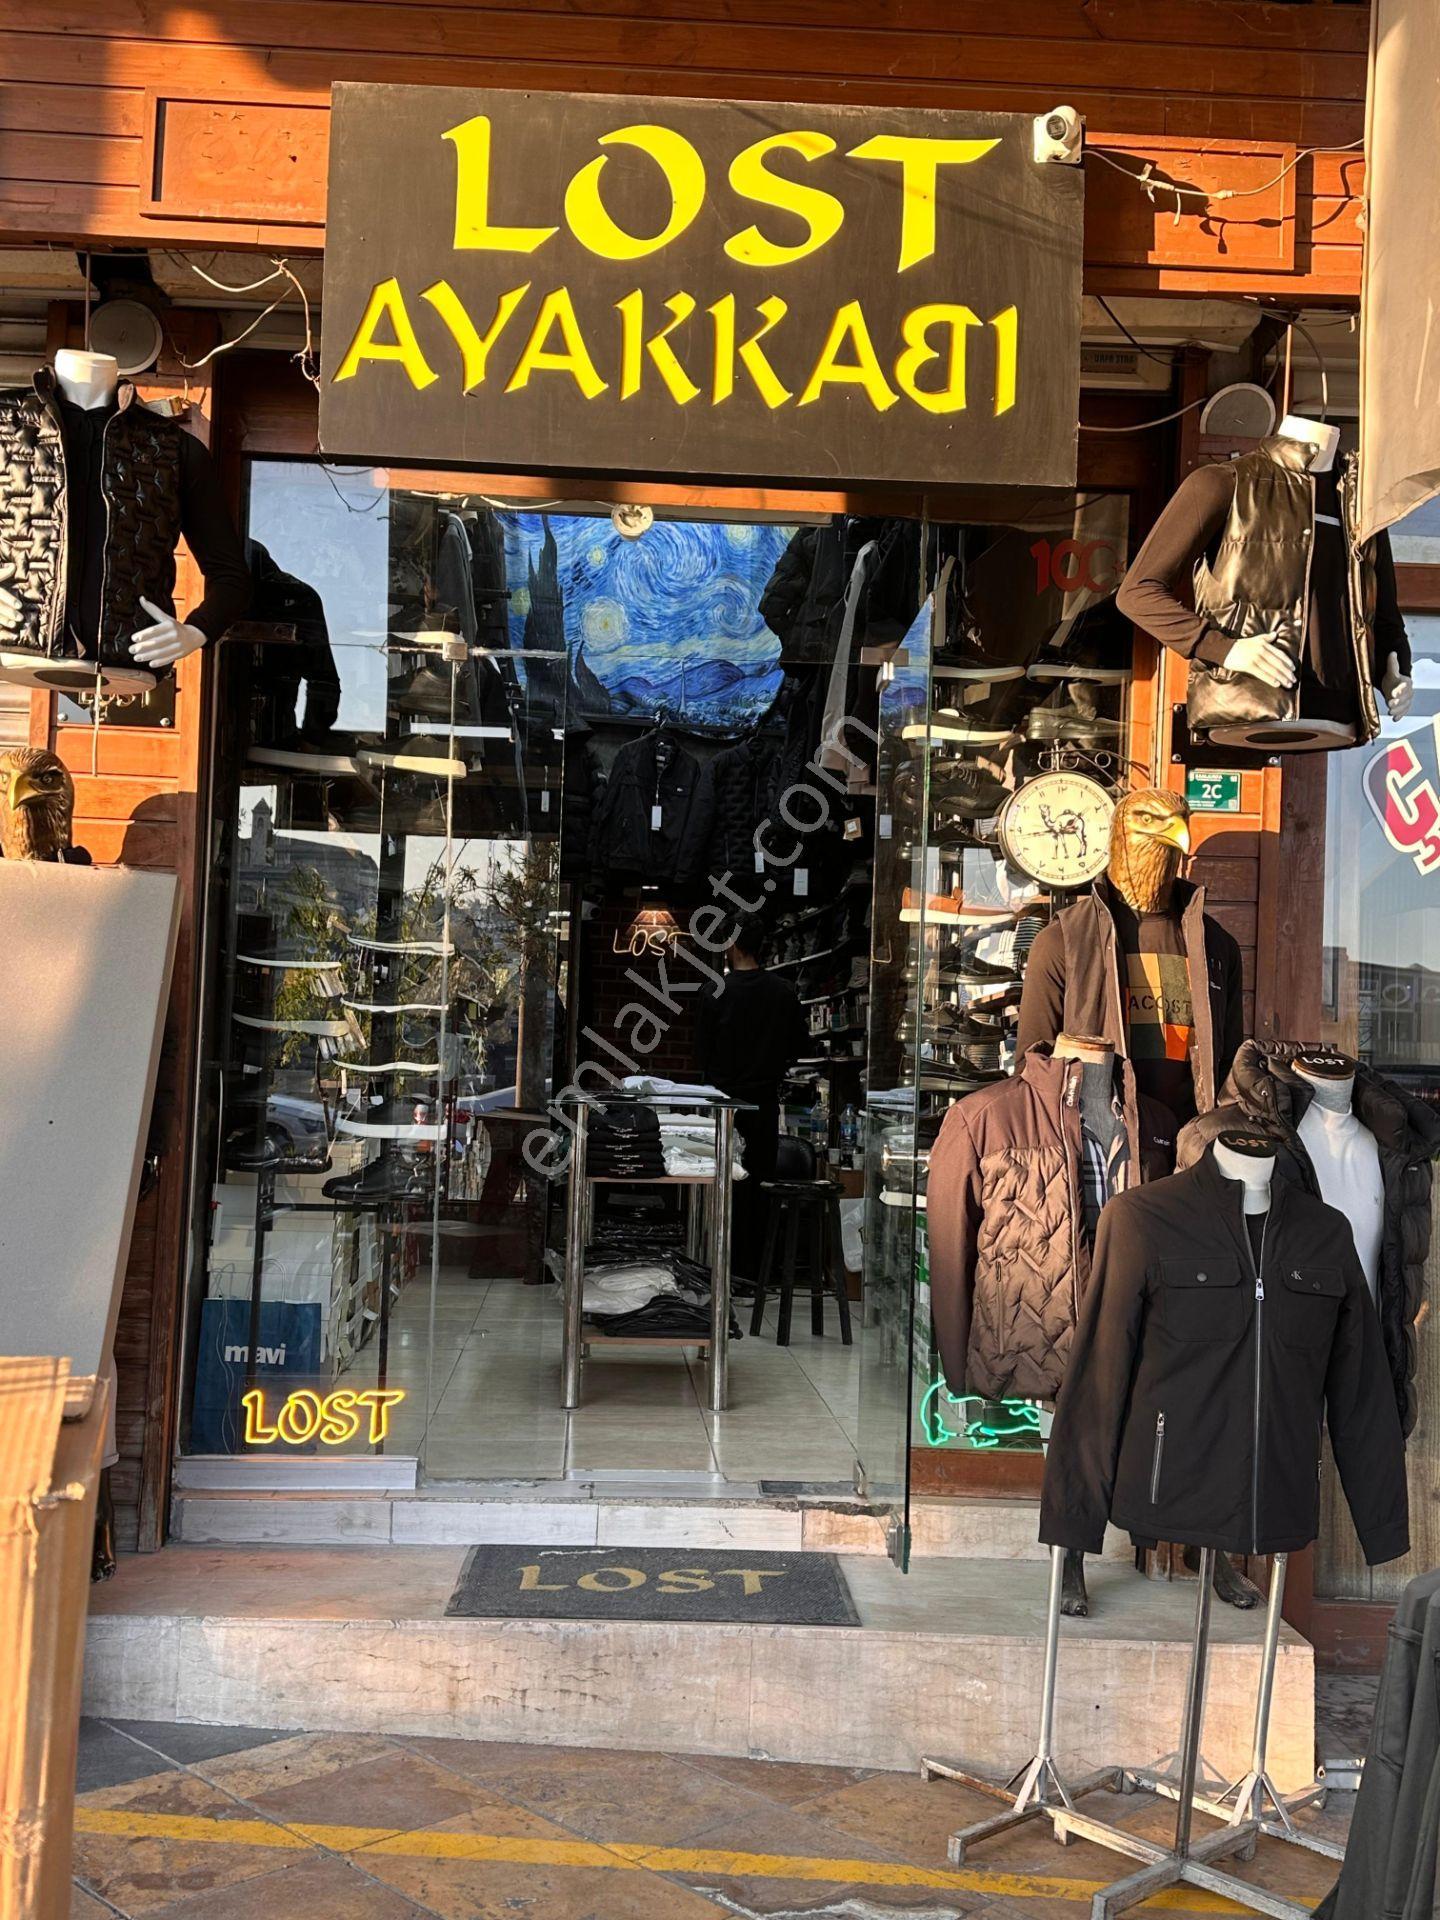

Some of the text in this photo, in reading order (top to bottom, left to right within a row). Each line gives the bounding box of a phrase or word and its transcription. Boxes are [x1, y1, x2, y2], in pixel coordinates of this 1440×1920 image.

[441, 115, 1003, 273] LOST
[330, 276, 1018, 416] AYAKKABI
[1201, 783, 1223, 799] 2C
[613, 929, 694, 959] LOST
[1301, 1056, 1346, 1067] LOST
[1223, 1137, 1269, 1148] LOST
[224, 1342, 287, 1366] mavi
[242, 1389, 405, 1444] LOST
[517, 1564, 789, 1596] LOST
